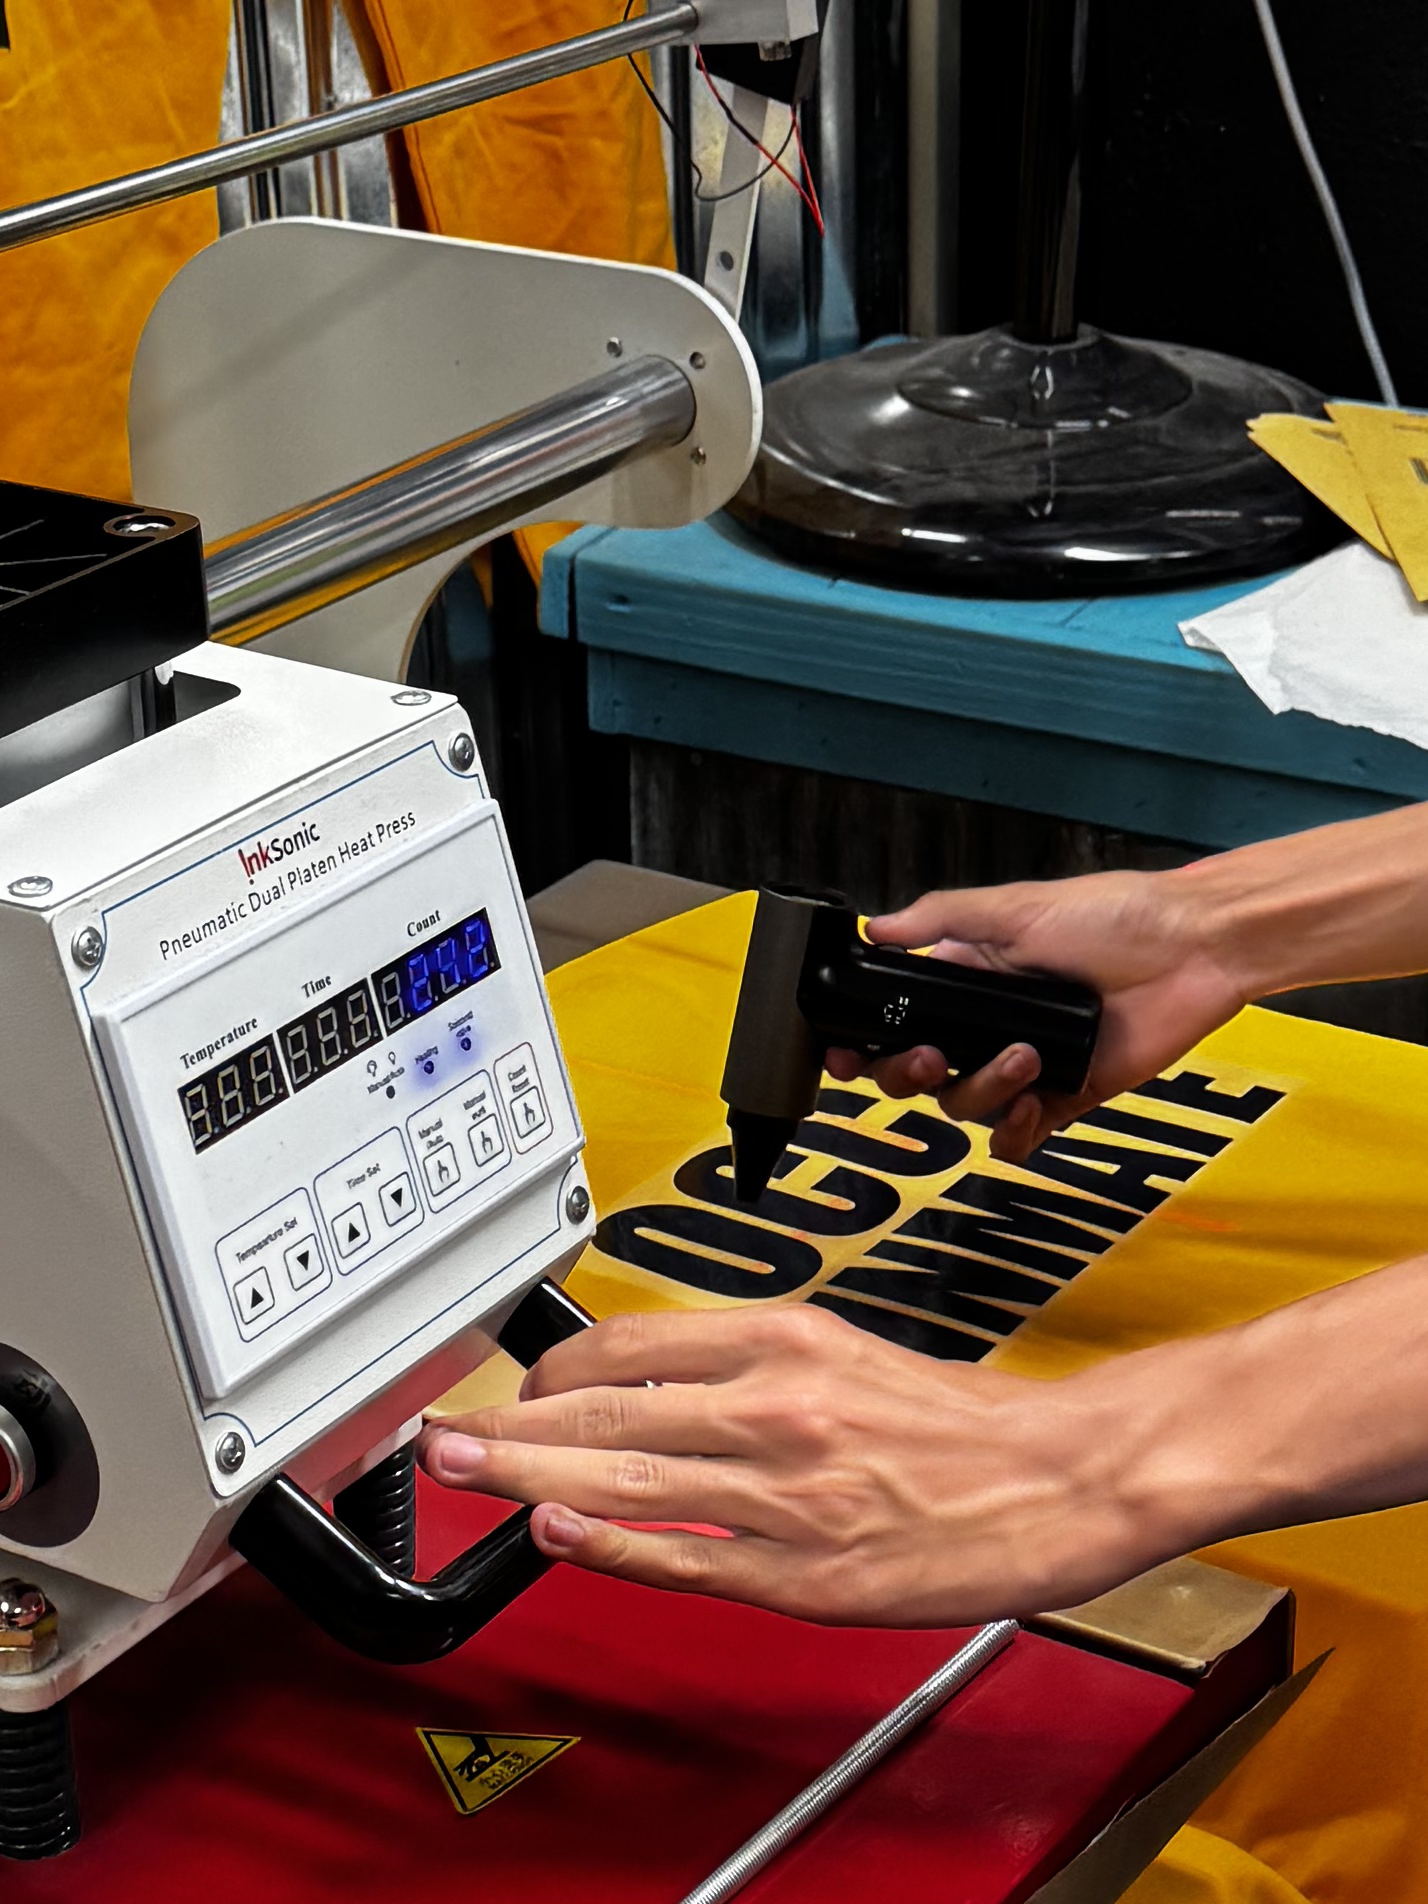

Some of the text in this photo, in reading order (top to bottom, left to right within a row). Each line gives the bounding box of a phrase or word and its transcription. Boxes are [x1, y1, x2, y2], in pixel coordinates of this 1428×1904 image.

[159, 810, 417, 961] Pneumatic Dual Platen Heat Press
[237, 821, 321, 886] InkSonic
[406, 909, 442, 938] Count
[301, 973, 333, 999] Time
[179, 1017, 259, 1071] Temperature
[591, 1086, 992, 1300] OCC
[804, 1070, 1288, 1364] INMATE
